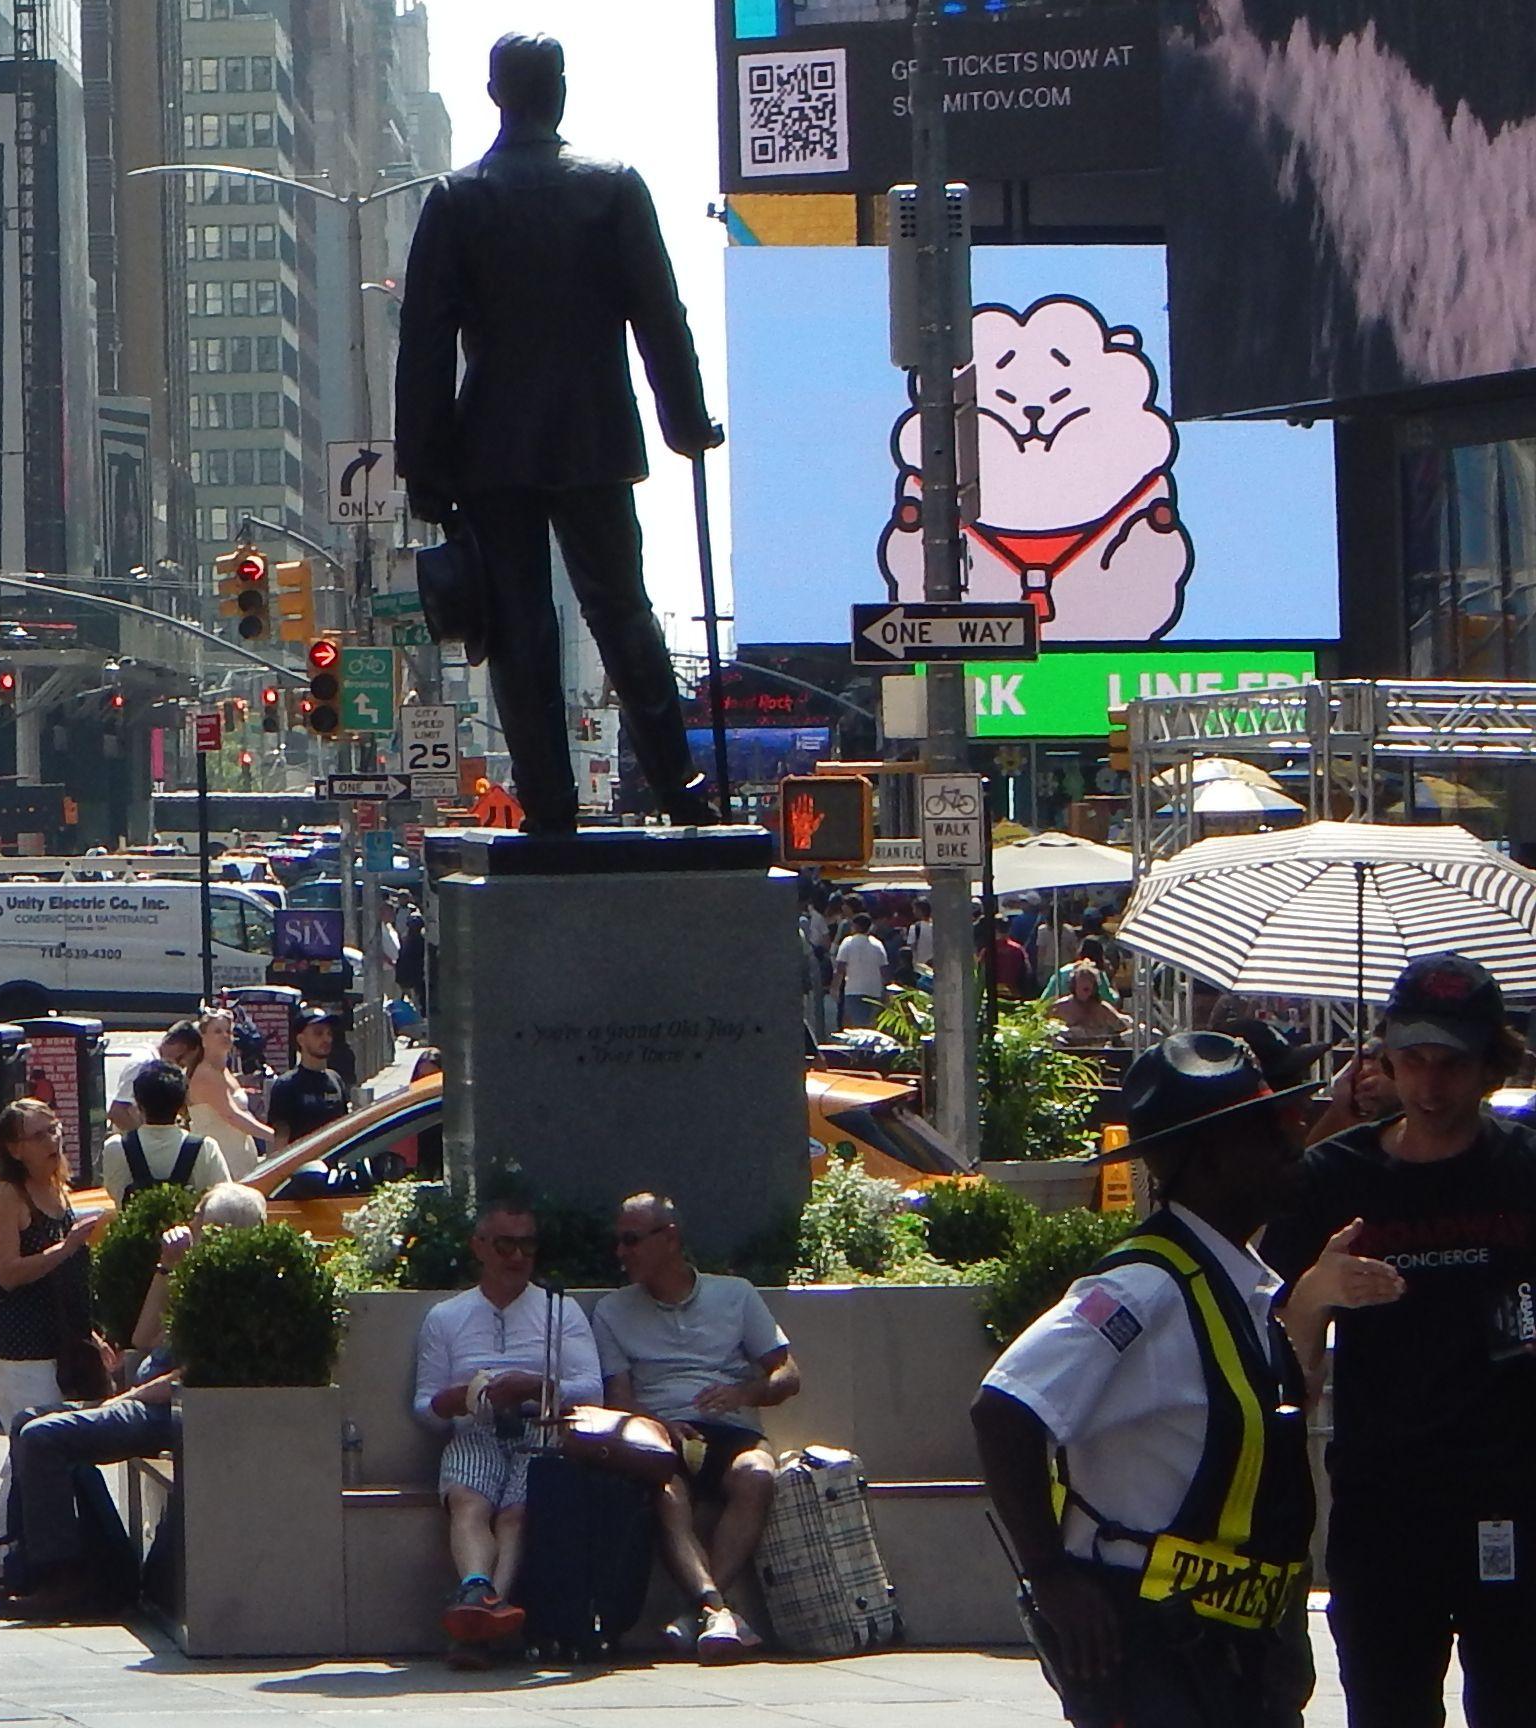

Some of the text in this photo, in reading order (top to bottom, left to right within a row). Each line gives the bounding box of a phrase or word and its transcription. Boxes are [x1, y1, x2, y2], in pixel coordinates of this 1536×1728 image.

[891, 46, 1134, 82] GE TICKETS NOW AT
[892, 86, 1072, 117] SMITOV.COM
[338, 501, 387, 517] ONLY
[880, 621, 1014, 645] ONE WAY
[411, 719, 446, 730] SPEED
[414, 730, 441, 740] LIMIT
[409, 743, 452, 771] 25
[337, 781, 398, 794] ONE WAY
[933, 822, 971, 837] WALK
[936, 843, 970, 858] BIKE
[6, 895, 171, 914] Unity Electric Co., Inc.
[13, 912, 83, 926] CONSTRUCTION
[94, 913, 160, 926] MAINTENANCE
[1383, 1247, 1489, 1270] CONCIERGE
